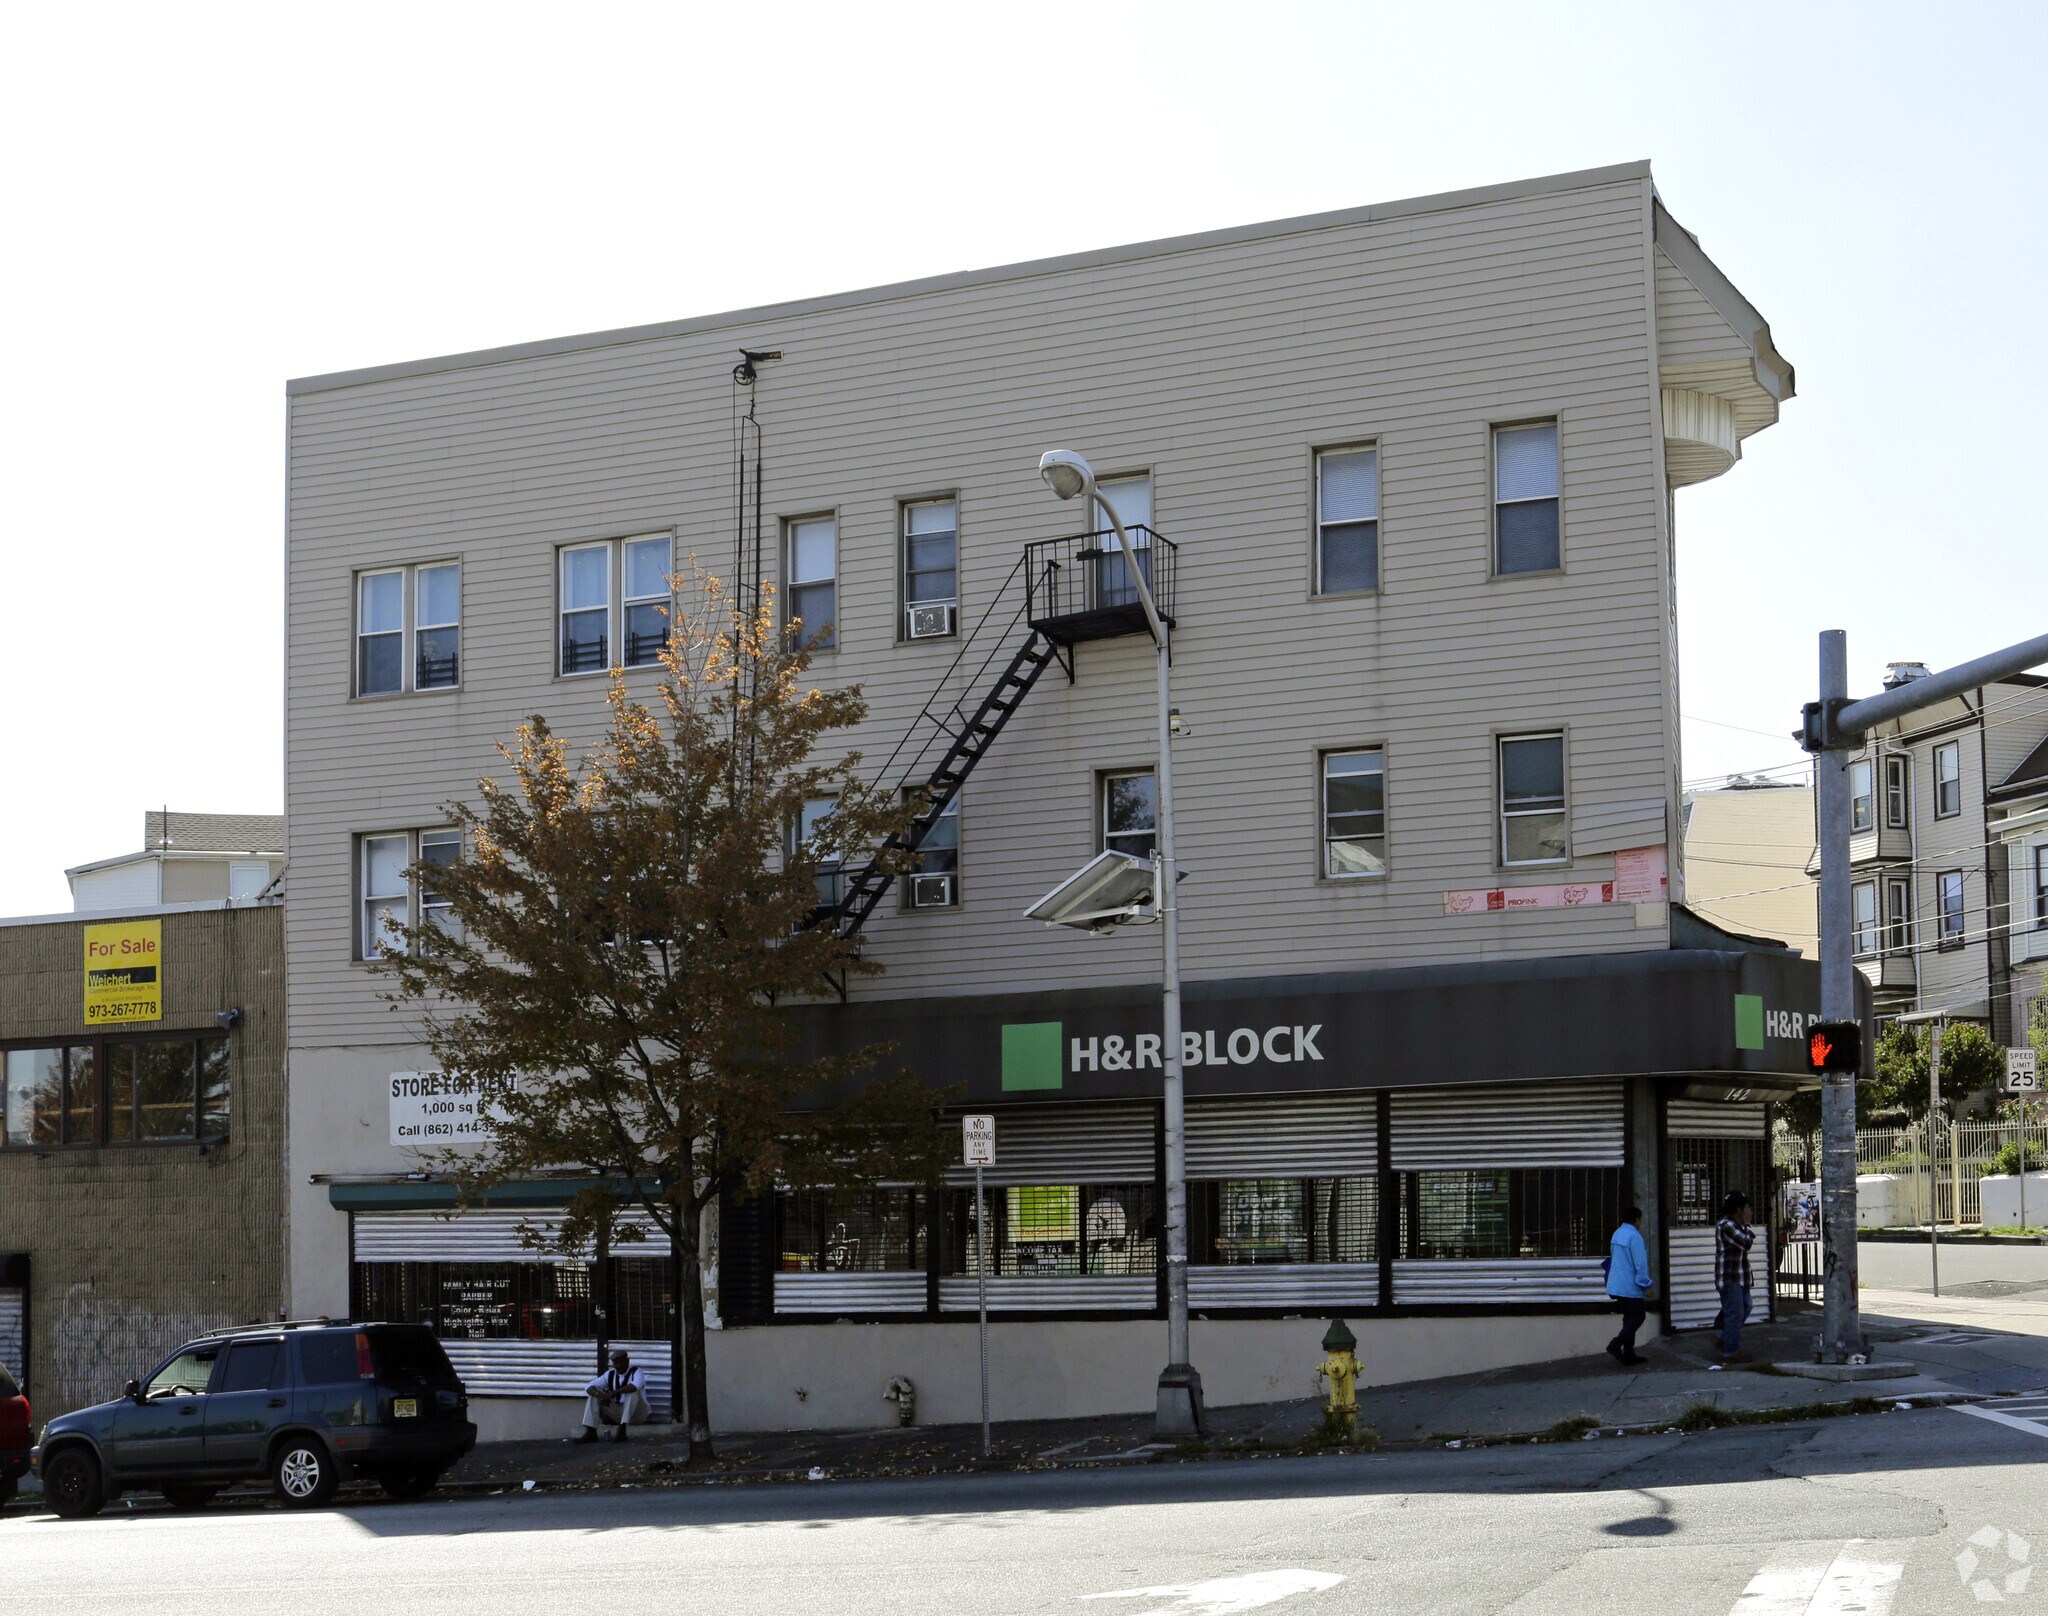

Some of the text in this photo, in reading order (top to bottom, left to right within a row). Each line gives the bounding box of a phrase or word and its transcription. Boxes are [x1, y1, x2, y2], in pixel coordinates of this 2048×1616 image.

[89, 938, 156, 956] For Sale
[89, 973, 131, 986] Weichert
[89, 1001, 157, 1017] 973-267-7778
[1766, 1010, 1804, 1039] H&R
[1071, 1024, 1324, 1072] H&R BLOCK
[2010, 1052, 2033, 1060] SPEED
[2011, 1071, 2033, 1086] 25
[392, 1078, 439, 1097] STORE
[1723, 1088, 1751, 1101] 142
[421, 1101, 455, 1115] 1,000
[458, 1103, 472, 1114] sq
[398, 1125, 420, 1136] Call
[424, 1124, 453, 1137] (862)
[973, 1120, 985, 1129] NO
[966, 1131, 992, 1140] PARKING
